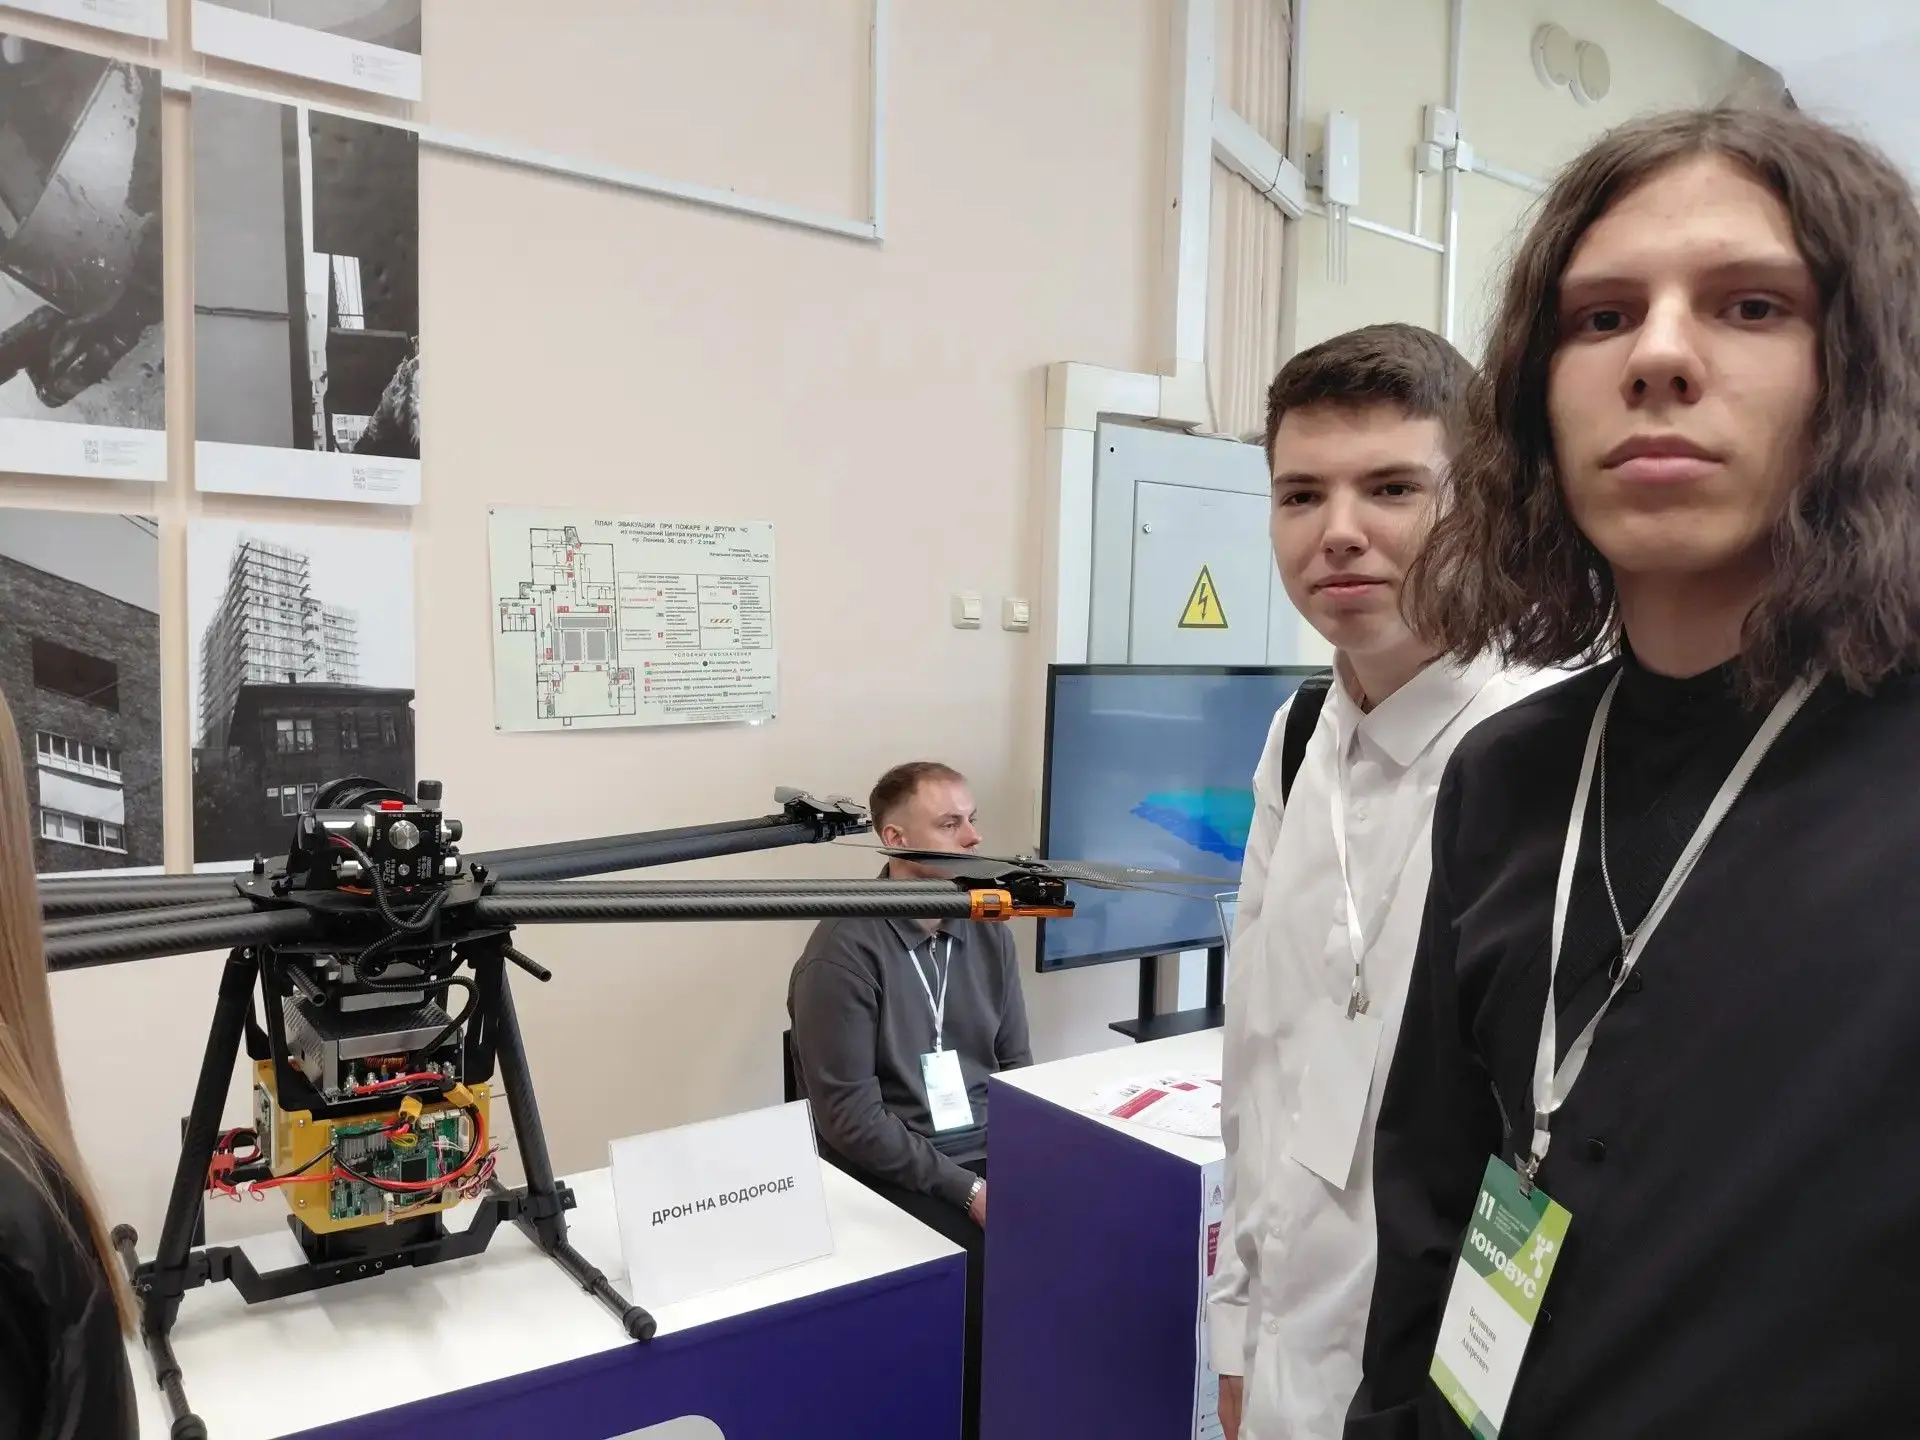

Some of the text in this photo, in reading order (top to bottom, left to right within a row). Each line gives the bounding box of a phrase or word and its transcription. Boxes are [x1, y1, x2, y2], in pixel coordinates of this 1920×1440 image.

[618, 521, 656, 530] ЭВАКУАЦИИ
[652, 1176, 795, 1226] ДРОН НА ВОДОРОДЕ
[1478, 1190, 1496, 1221] 11
[1470, 1227, 1537, 1299] ЮНОВУС
